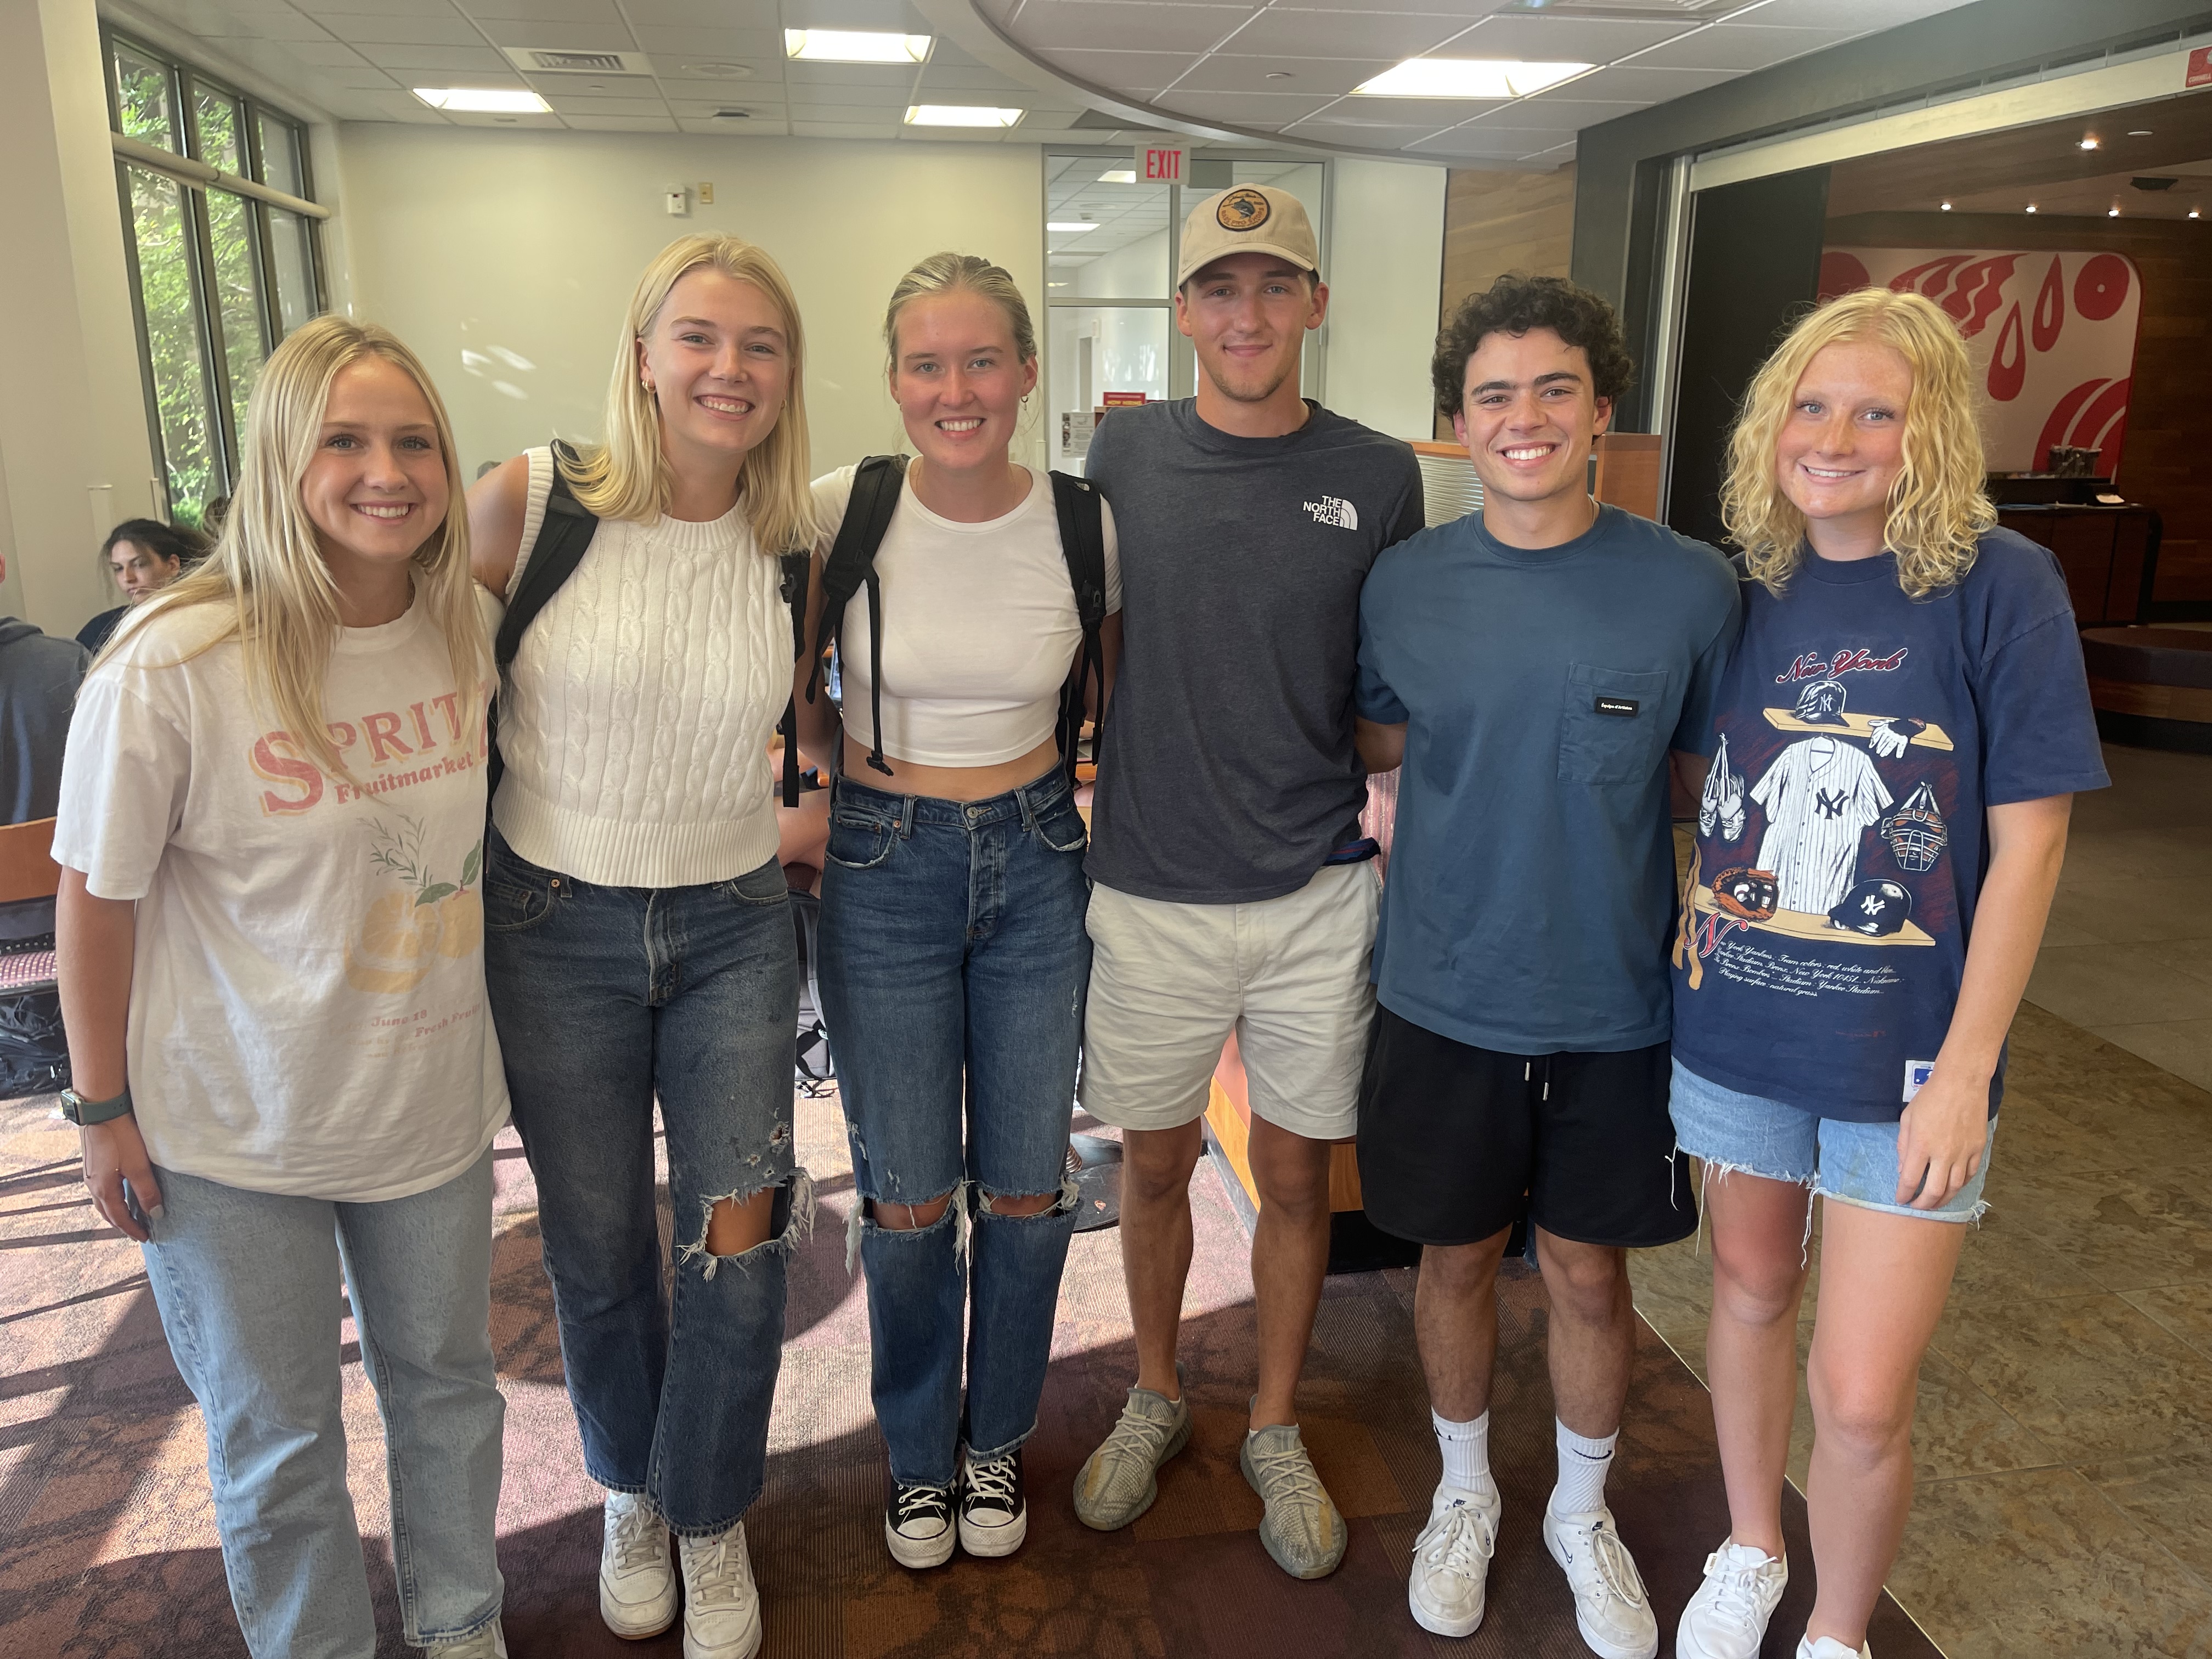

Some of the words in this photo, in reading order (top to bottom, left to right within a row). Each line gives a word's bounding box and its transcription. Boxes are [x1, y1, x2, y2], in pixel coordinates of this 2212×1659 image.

[1147, 149, 1182, 179] EXIT
[1303, 501, 1341, 517] NORTH
[1322, 495, 1342, 508] THE
[1313, 512, 1340, 526] FACE
[1776, 652, 1827, 683] New
[1827, 648, 1908, 679] York
[1819, 693, 1833, 711] NY
[334, 751, 474, 804] Fruitmarket
[1814, 787, 1850, 820] NY
[1860, 894, 1886, 916] NY
[1778, 954, 1799, 965] Team
[1841, 964, 1863, 973] white
[1790, 967, 1810, 976] New
[1810, 968, 1835, 979] York
[1718, 967, 1743, 983] Playing
[1769, 984, 1801, 993] natural
[1816, 979, 1846, 991] Yankee
[371, 1015, 409, 1027] June
[413, 1009, 427, 1022] 18
[415, 1017, 448, 1037] Fresh
